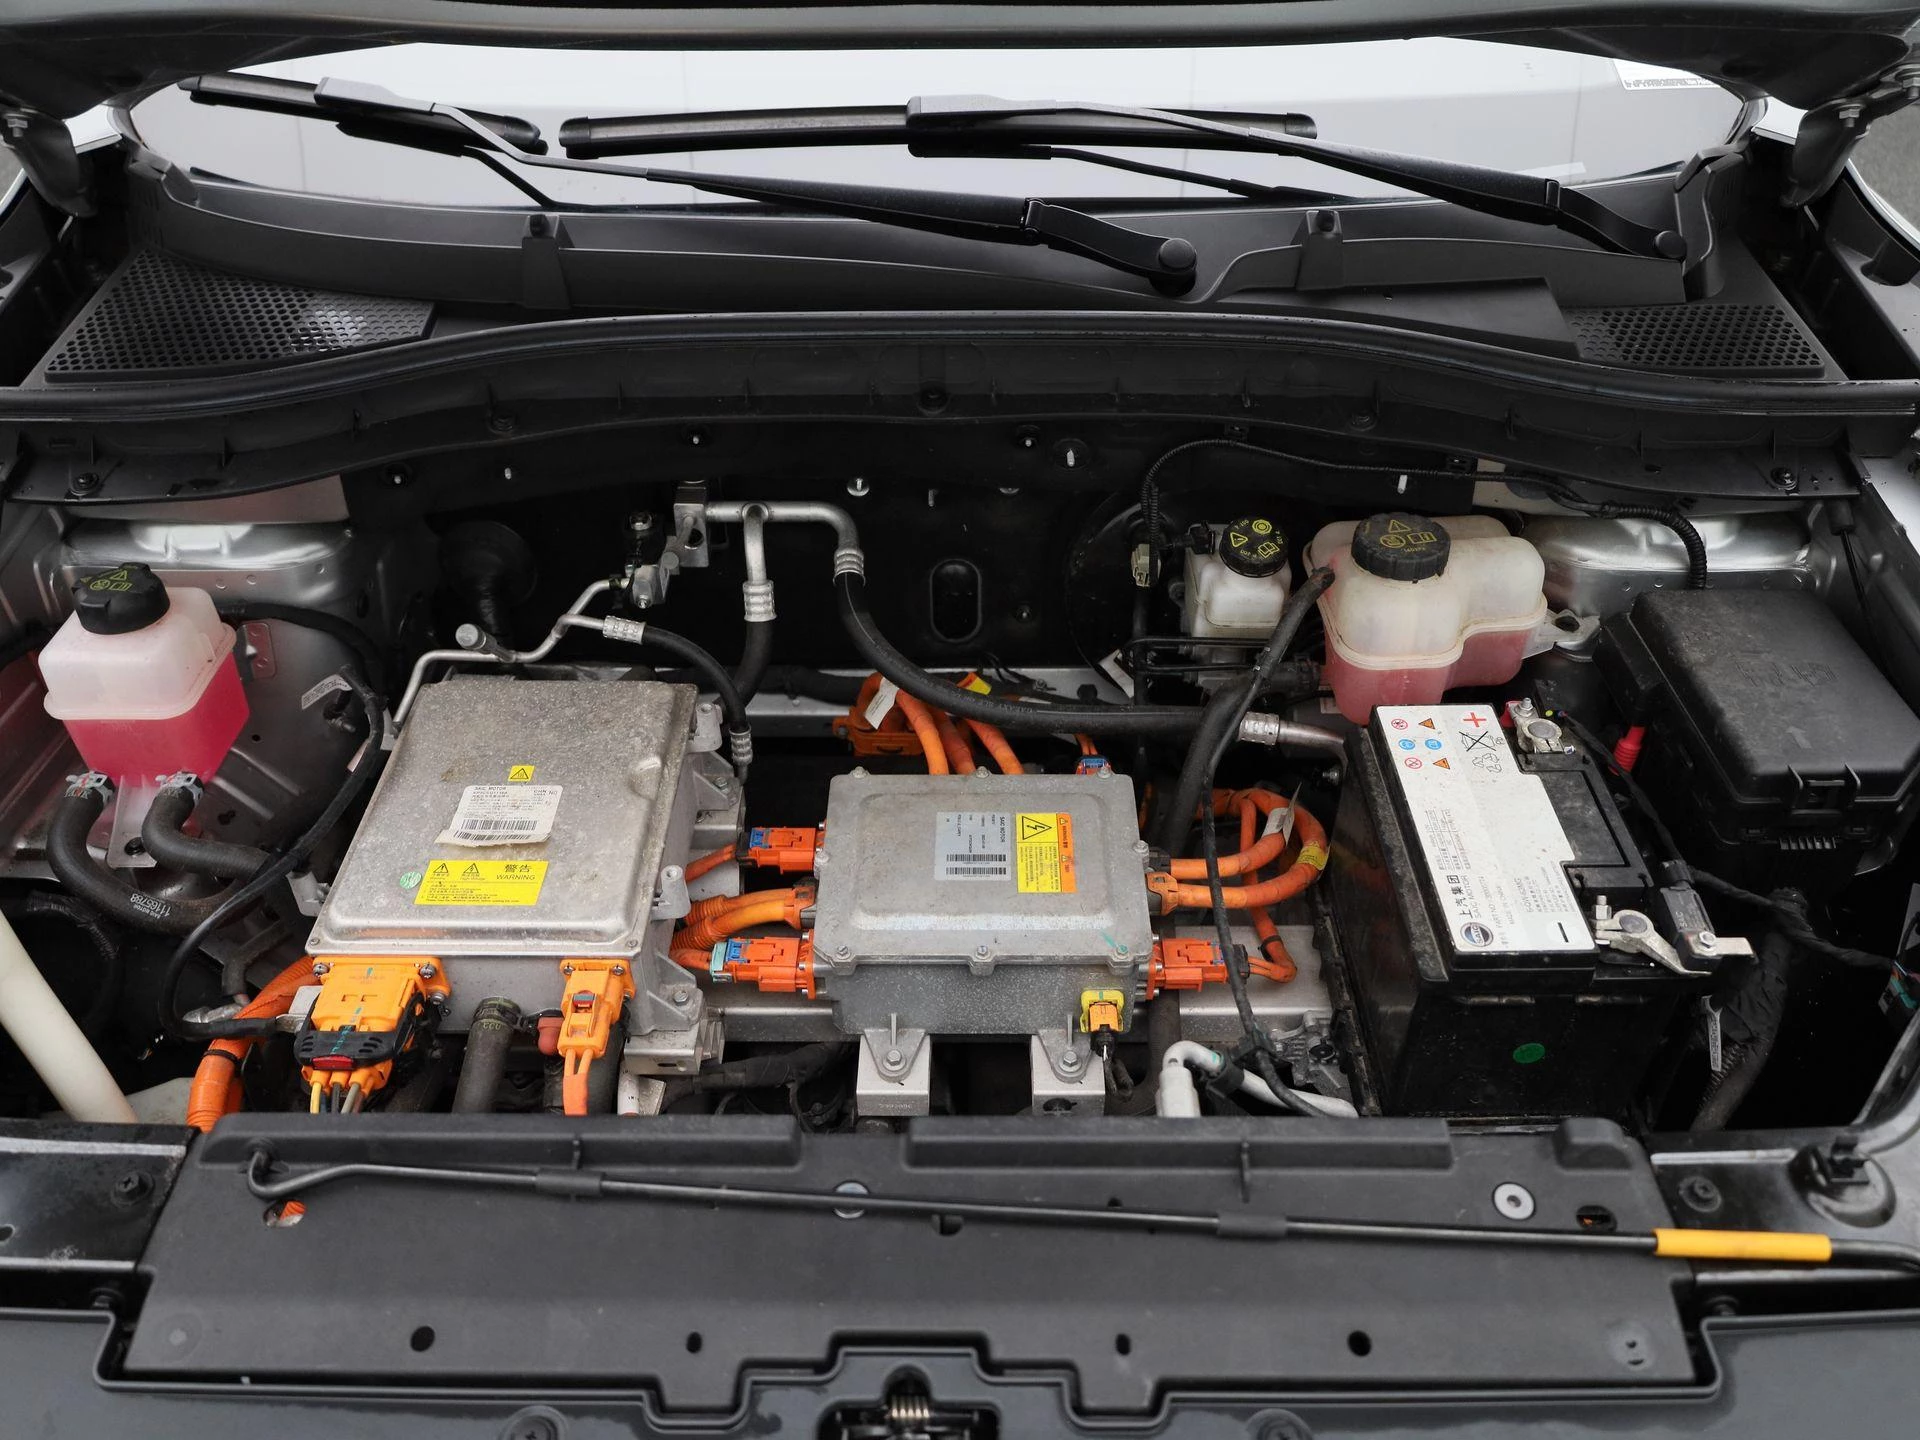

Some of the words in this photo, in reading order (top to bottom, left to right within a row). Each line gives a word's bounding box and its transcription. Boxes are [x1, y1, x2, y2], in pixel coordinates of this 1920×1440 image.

[504, 863, 532, 873] 警告
[1445, 874, 1473, 918] 上汽集团
[1459, 874, 1475, 899] MOTOR
[130, 893, 171, 917] 11165788
[1468, 900, 1482, 918] SAIC
[1471, 925, 1484, 944] SAIC
